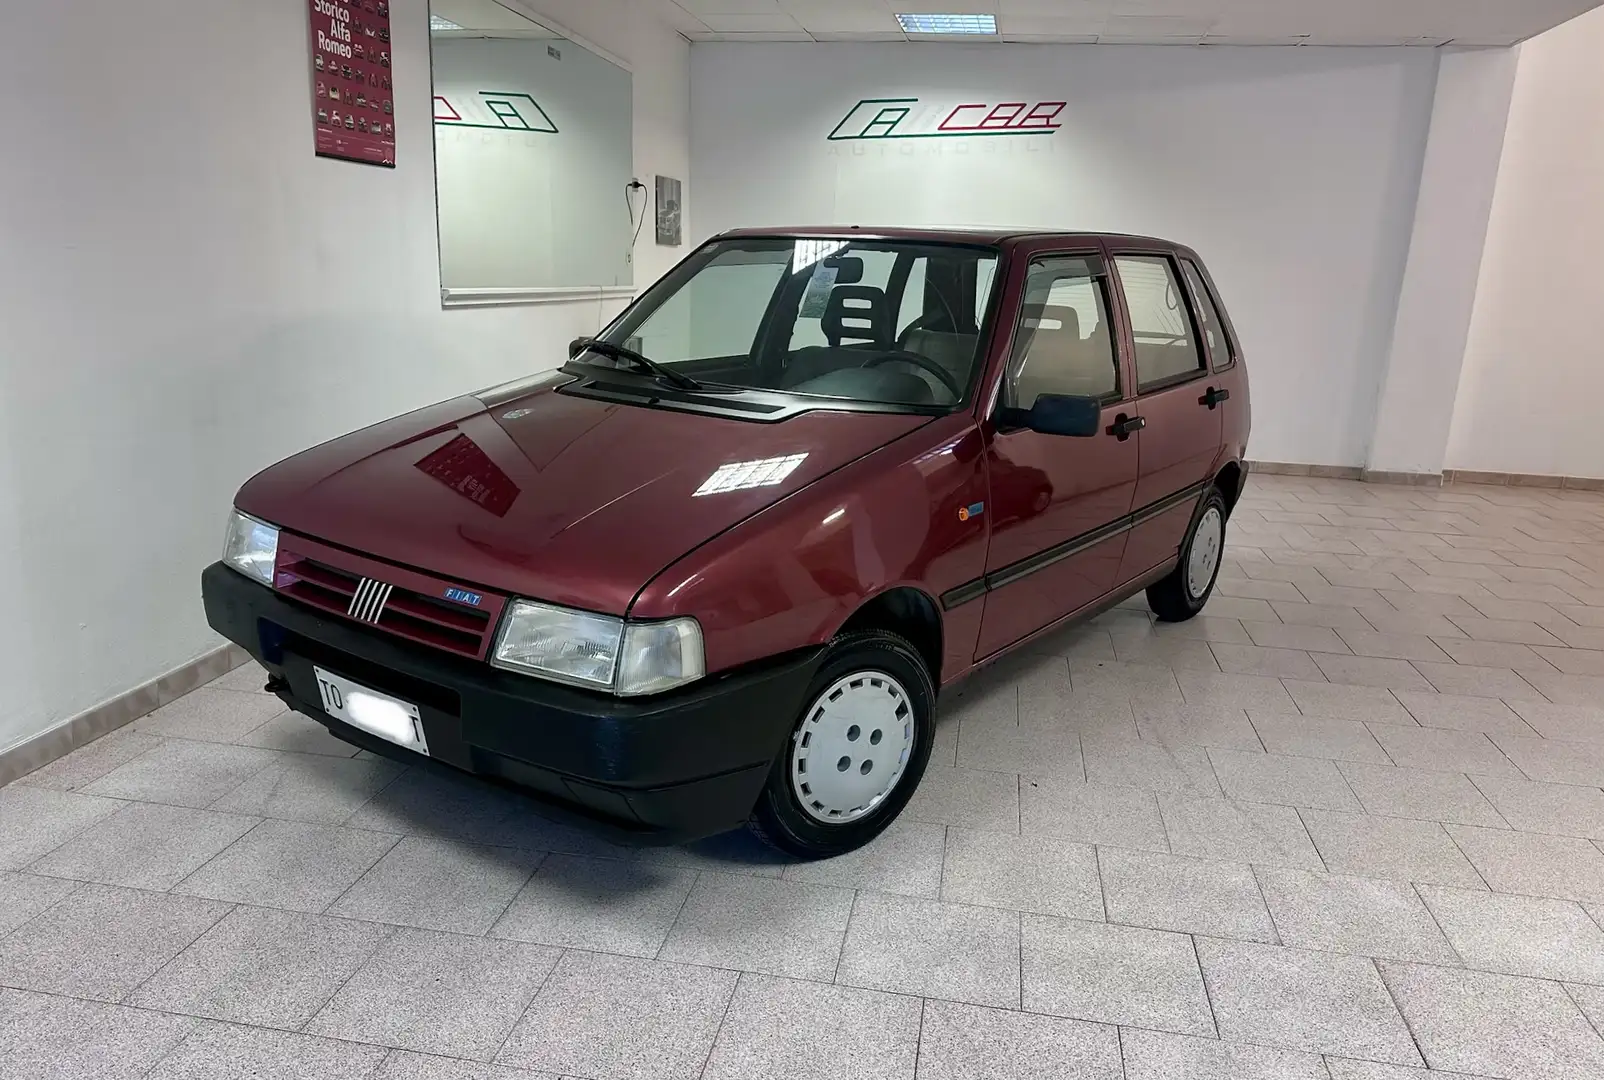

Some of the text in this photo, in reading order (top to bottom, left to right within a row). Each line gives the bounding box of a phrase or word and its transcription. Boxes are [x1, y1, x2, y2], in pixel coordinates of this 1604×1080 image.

[314, 0, 350, 23] Storico
[330, 18, 351, 43] Alfa
[317, 29, 352, 59] Romeo
[937, 101, 1067, 131] CAR
[827, 141, 1056, 157] AUTOMOBILI
[446, 588, 480, 604] FIAT
